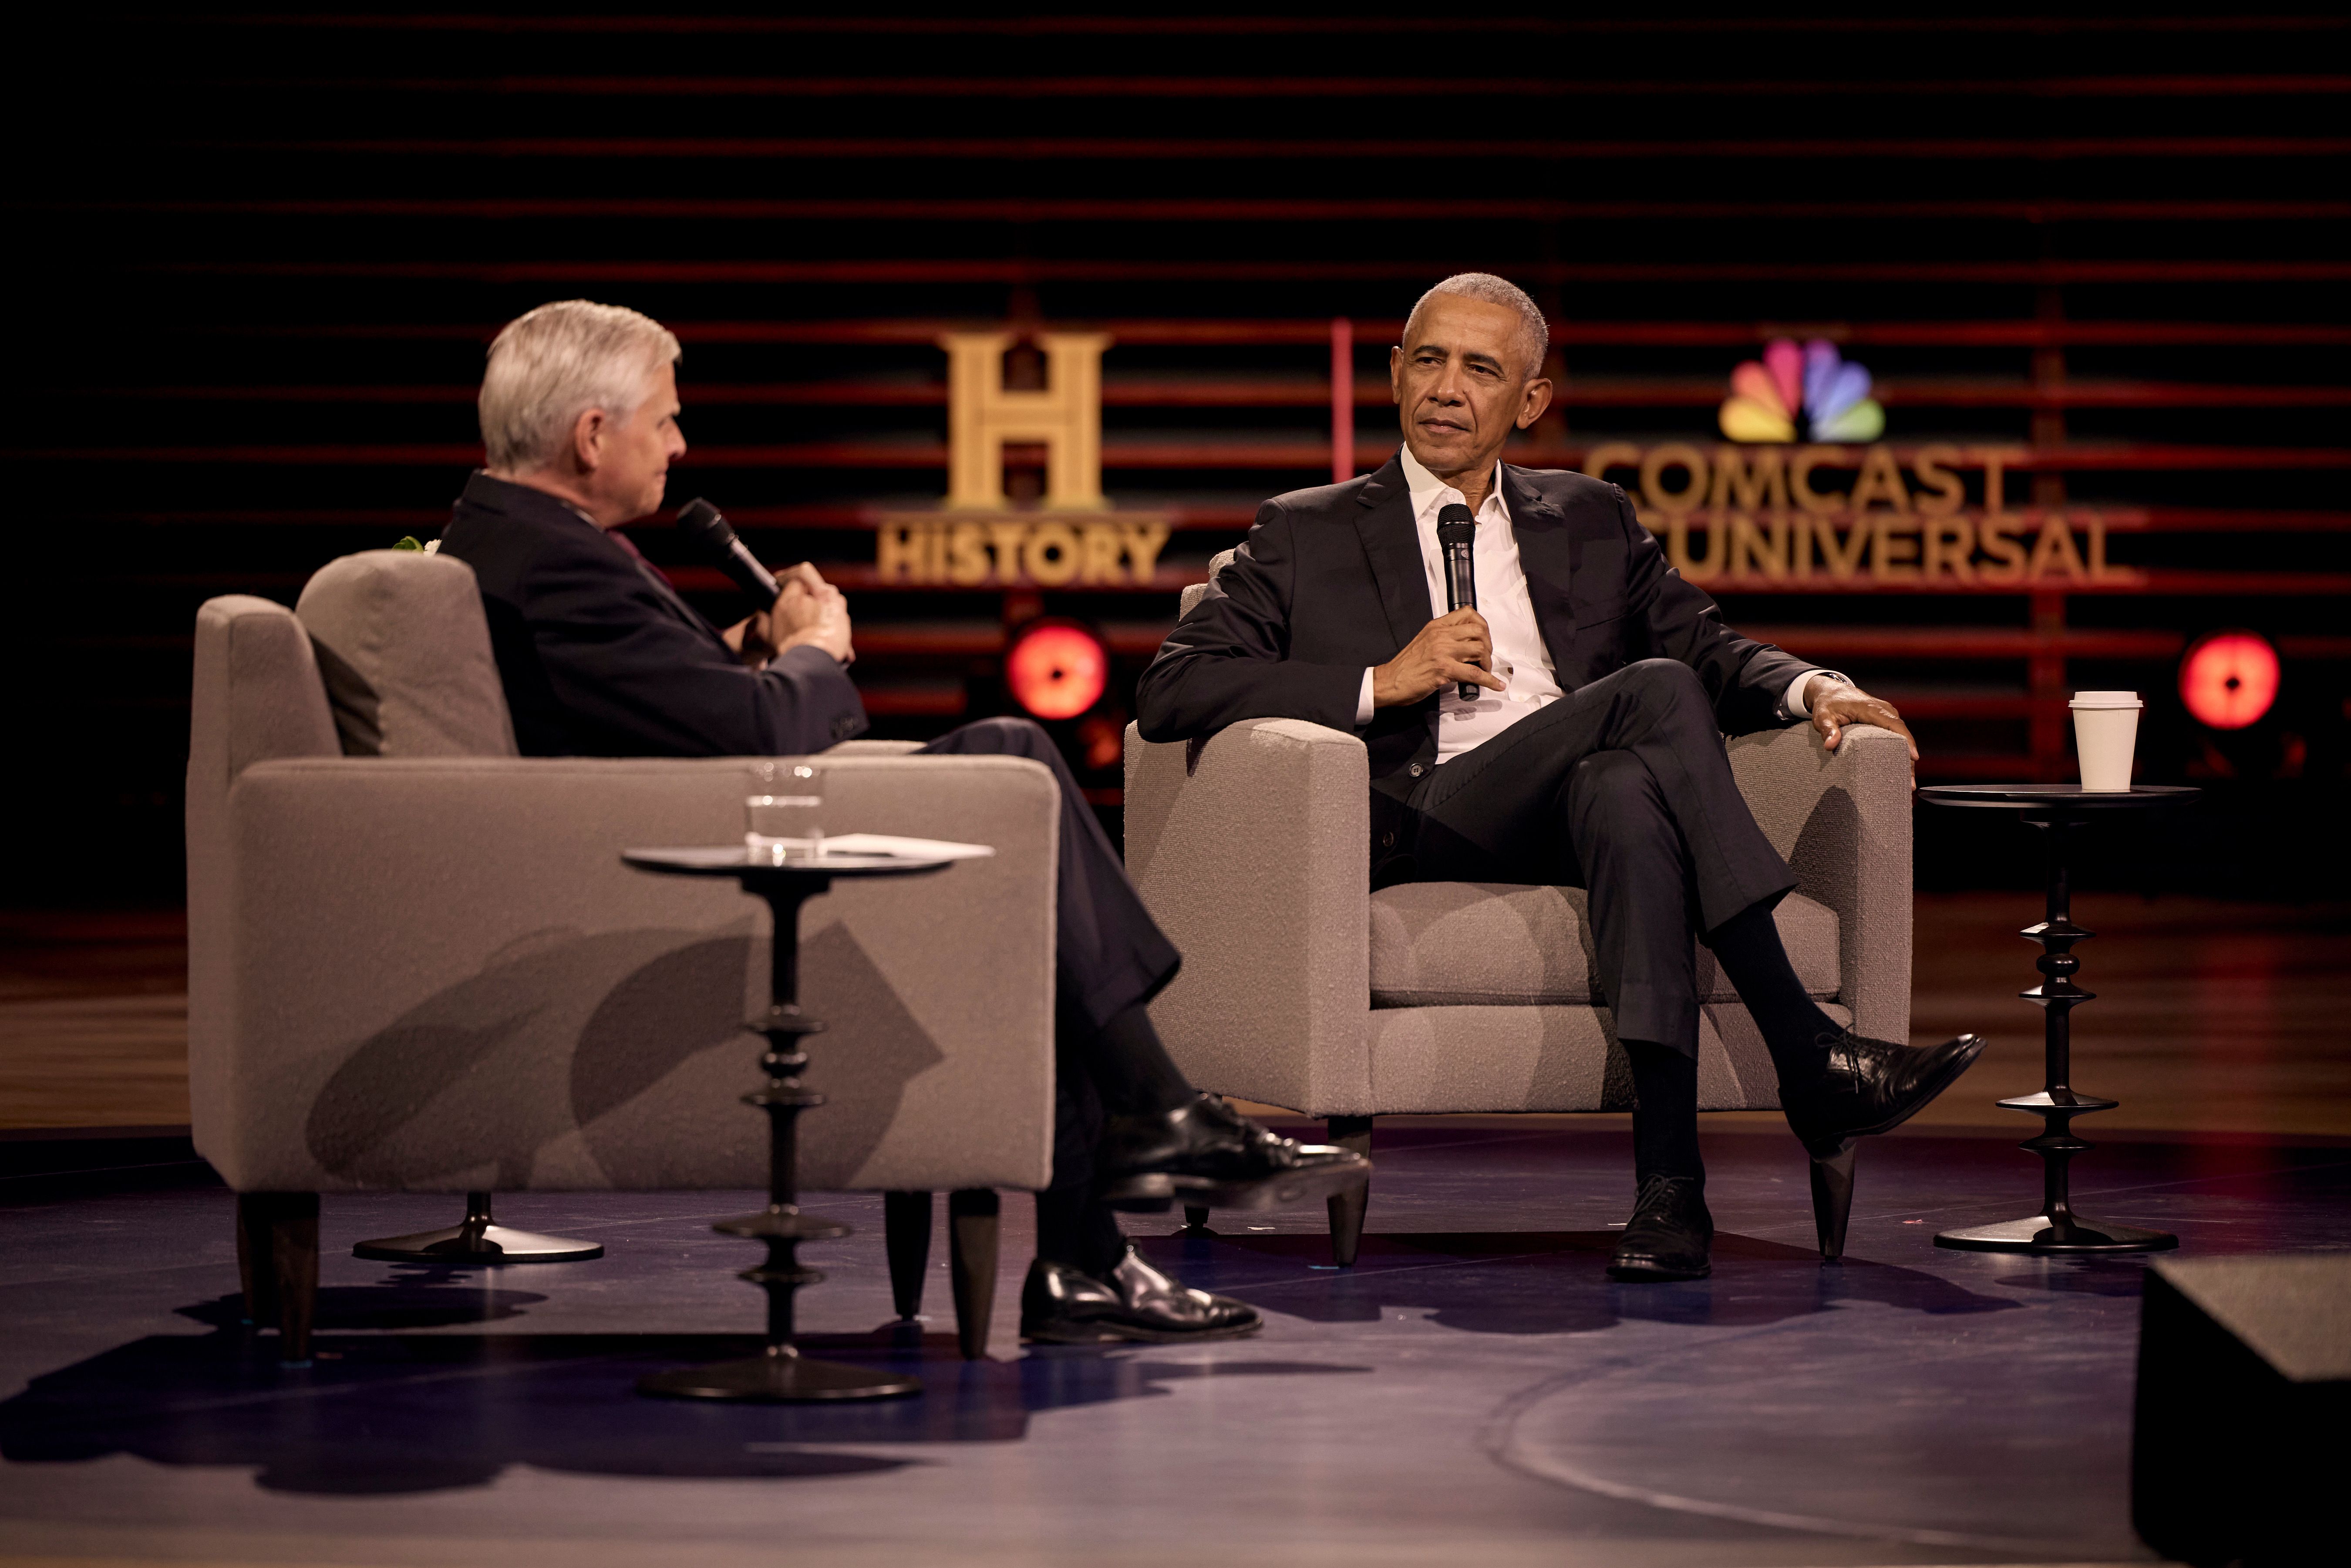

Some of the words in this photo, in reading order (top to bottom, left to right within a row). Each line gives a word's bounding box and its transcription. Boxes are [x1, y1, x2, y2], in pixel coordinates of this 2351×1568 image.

[939, 333, 1115, 512] H
[875, 522, 1170, 585] HISTORY
[1637, 512, 2141, 583] UNIVERSAL
